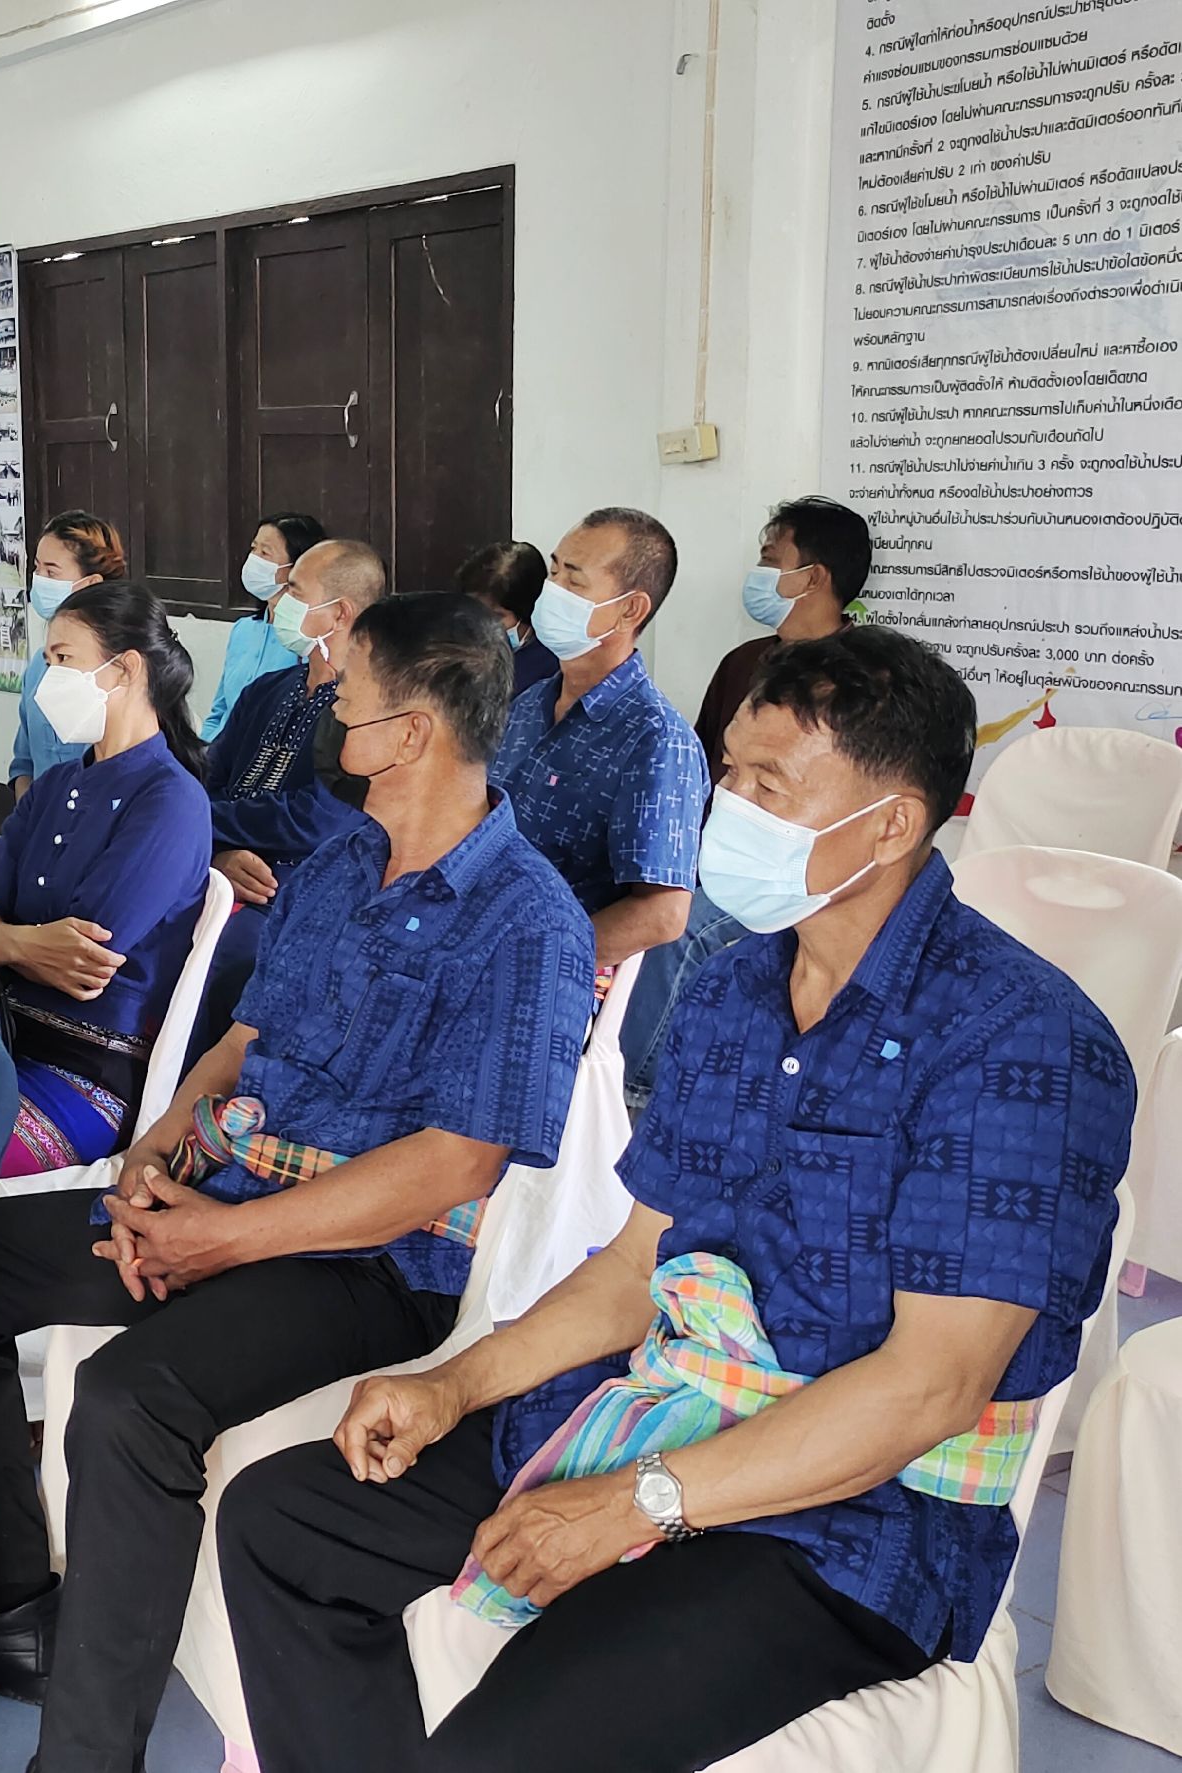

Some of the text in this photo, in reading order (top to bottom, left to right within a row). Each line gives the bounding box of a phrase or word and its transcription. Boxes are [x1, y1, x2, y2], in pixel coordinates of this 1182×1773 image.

[865, 46, 875, 57] 4.
[1135, 71, 1175, 91] ครั้งละ
[862, 99, 872, 111] 5.
[937, 140, 945, 152] 2
[958, 164, 965, 176] 2
[858, 205, 867, 216] 6.
[1106, 200, 1114, 212] 3
[857, 258, 866, 269] 7.
[1062, 234, 1070, 246] 5
[1075, 232, 1097, 244] บาท
[1127, 226, 1132, 238] 1
[1139, 219, 1181, 237] มิเตอร์
[855, 284, 866, 295] 8.
[852, 361, 863, 372] 9.
[851, 412, 867, 423] 10.
[850, 464, 866, 474] 11.
[1037, 459, 1045, 470] 3
[1050, 454, 1074, 470] ครั้ง
[1045, 648, 1079, 661] 3,000
[1084, 651, 1106, 663] บาท
[1112, 650, 1155, 666] ต่อครั้ง
